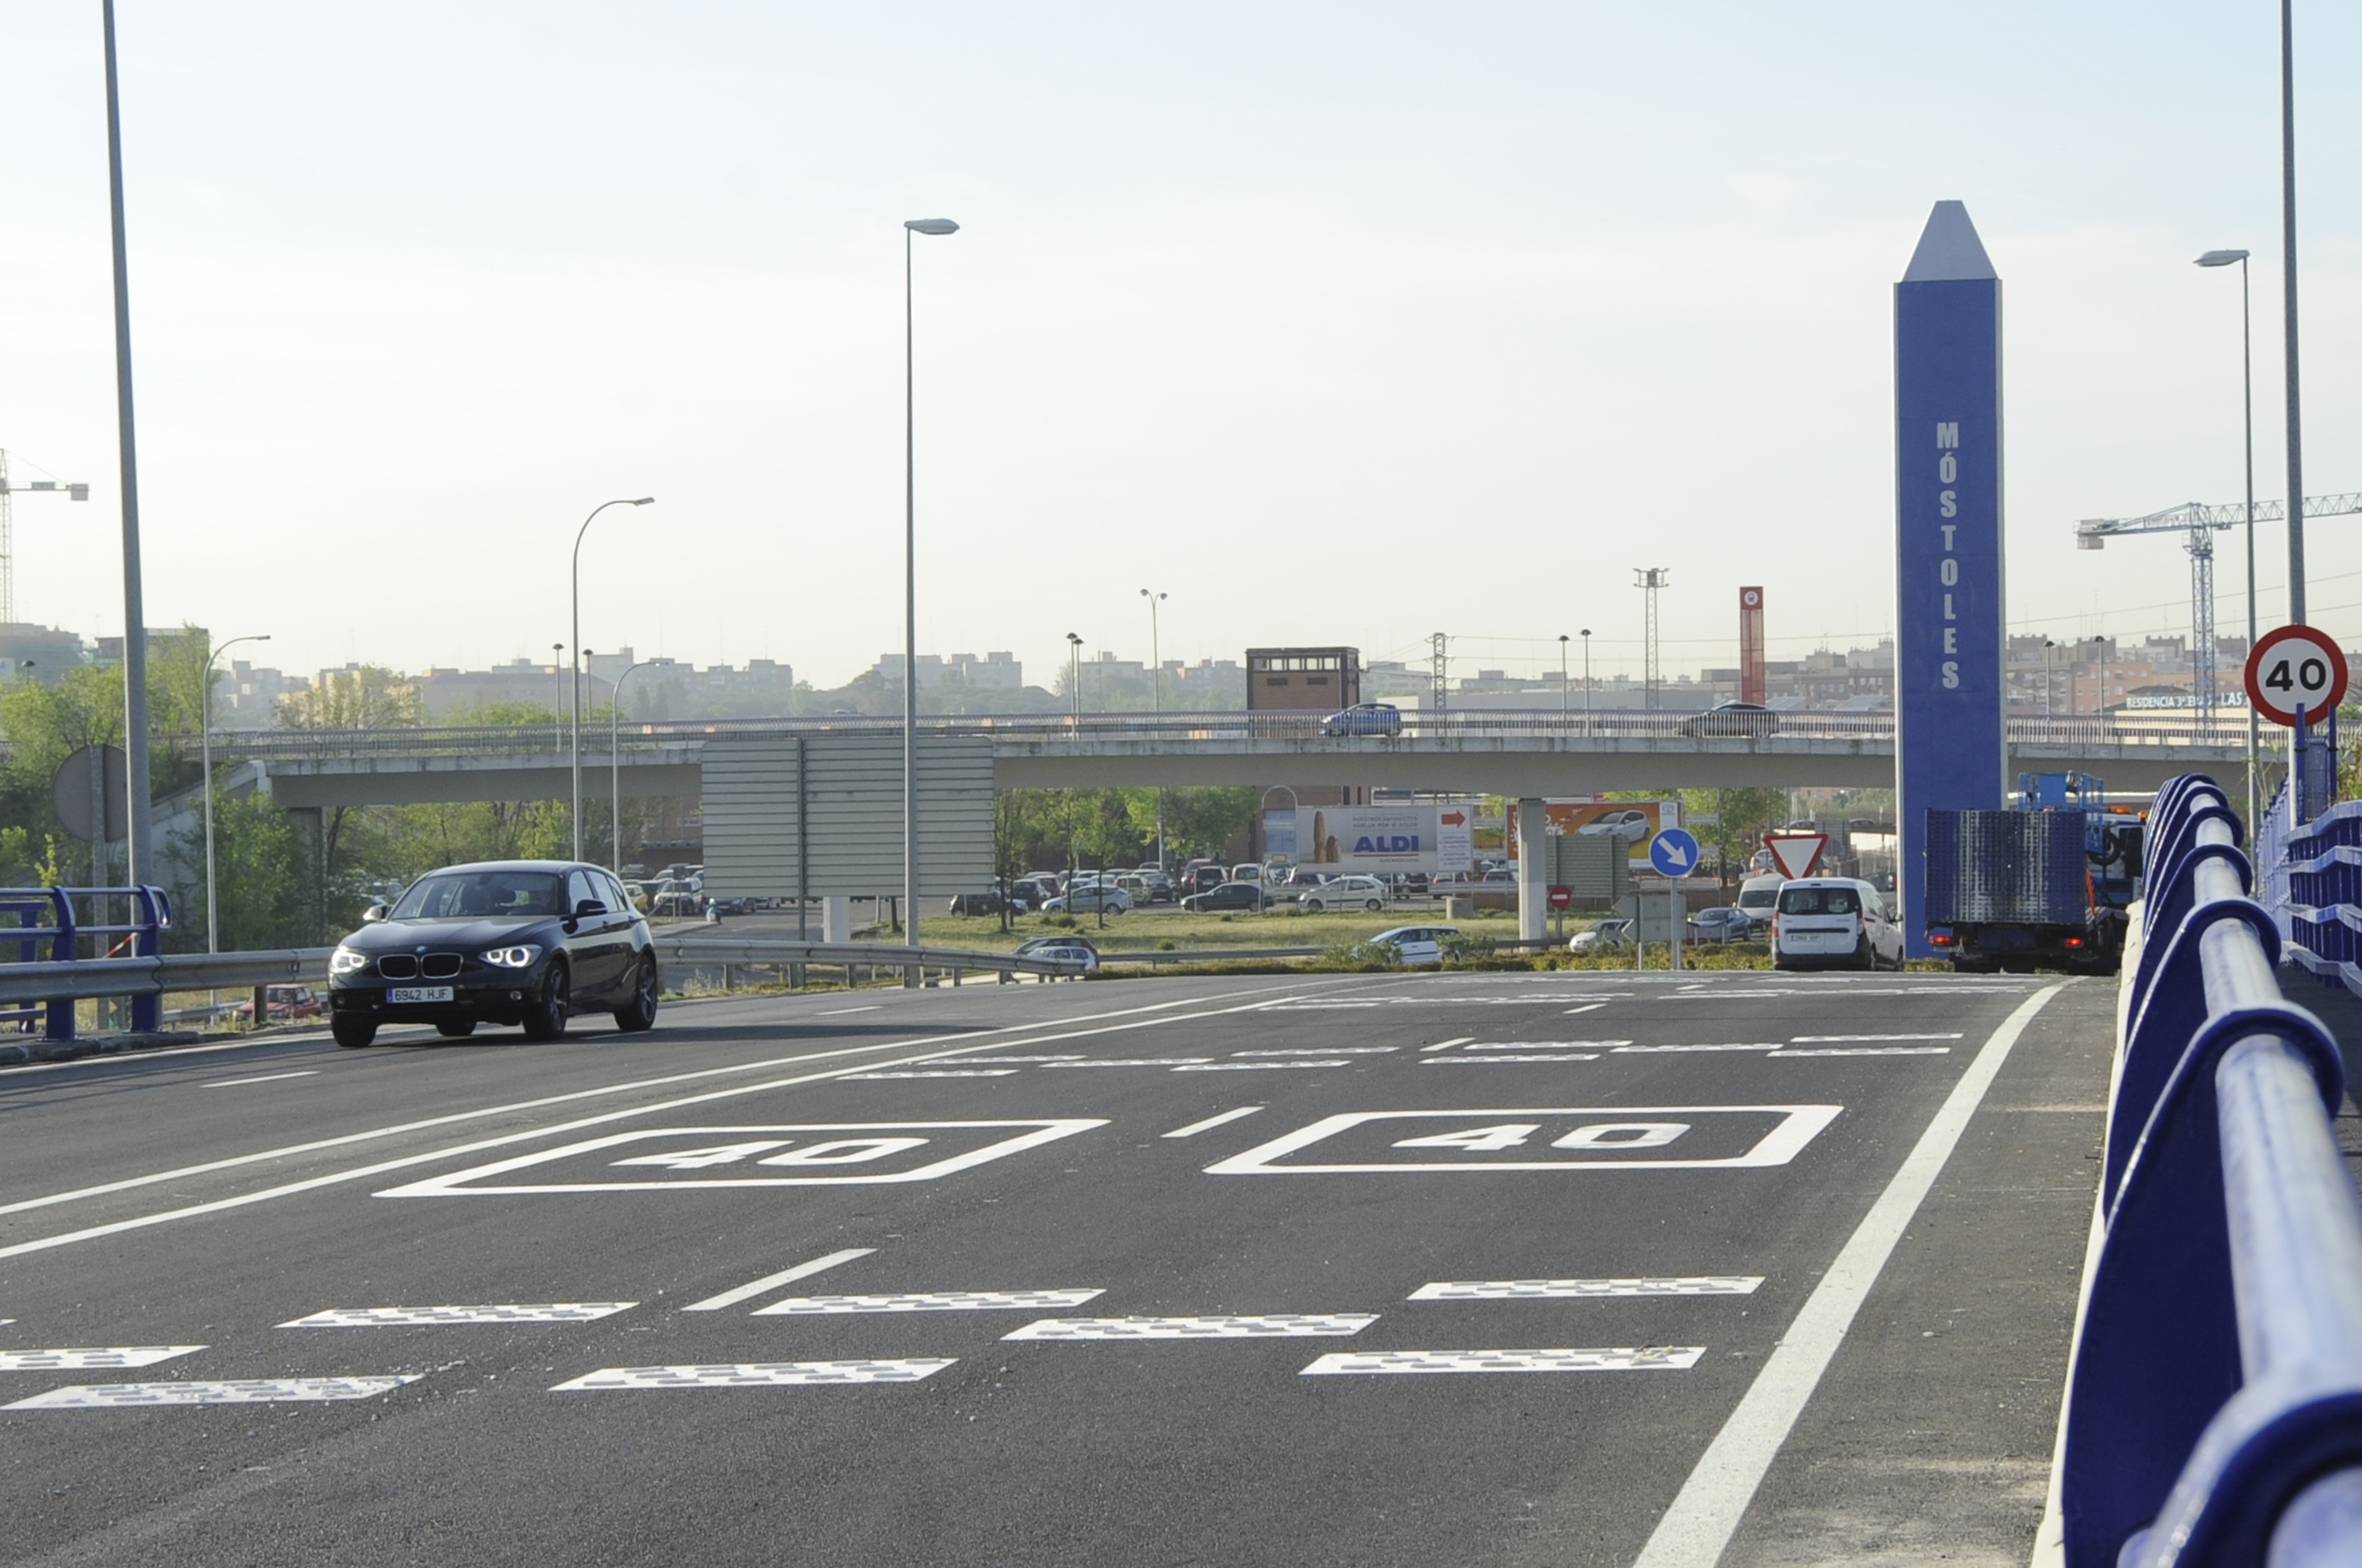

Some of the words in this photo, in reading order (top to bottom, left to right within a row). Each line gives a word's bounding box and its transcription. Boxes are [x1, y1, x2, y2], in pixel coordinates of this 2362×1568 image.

[1936, 422, 1960, 689] MÓSTOLES
[2265, 658, 2326, 692] 40
[2126, 696, 2174, 708] RESIDENCIA
[2220, 692, 2242, 705] LAS
[1353, 836, 1419, 852] ALDI
[395, 989, 422, 1000] 6942
[427, 988, 448, 1000] HJF
[1391, 1122, 1692, 1151] 40
[609, 1137, 931, 1170] 40
